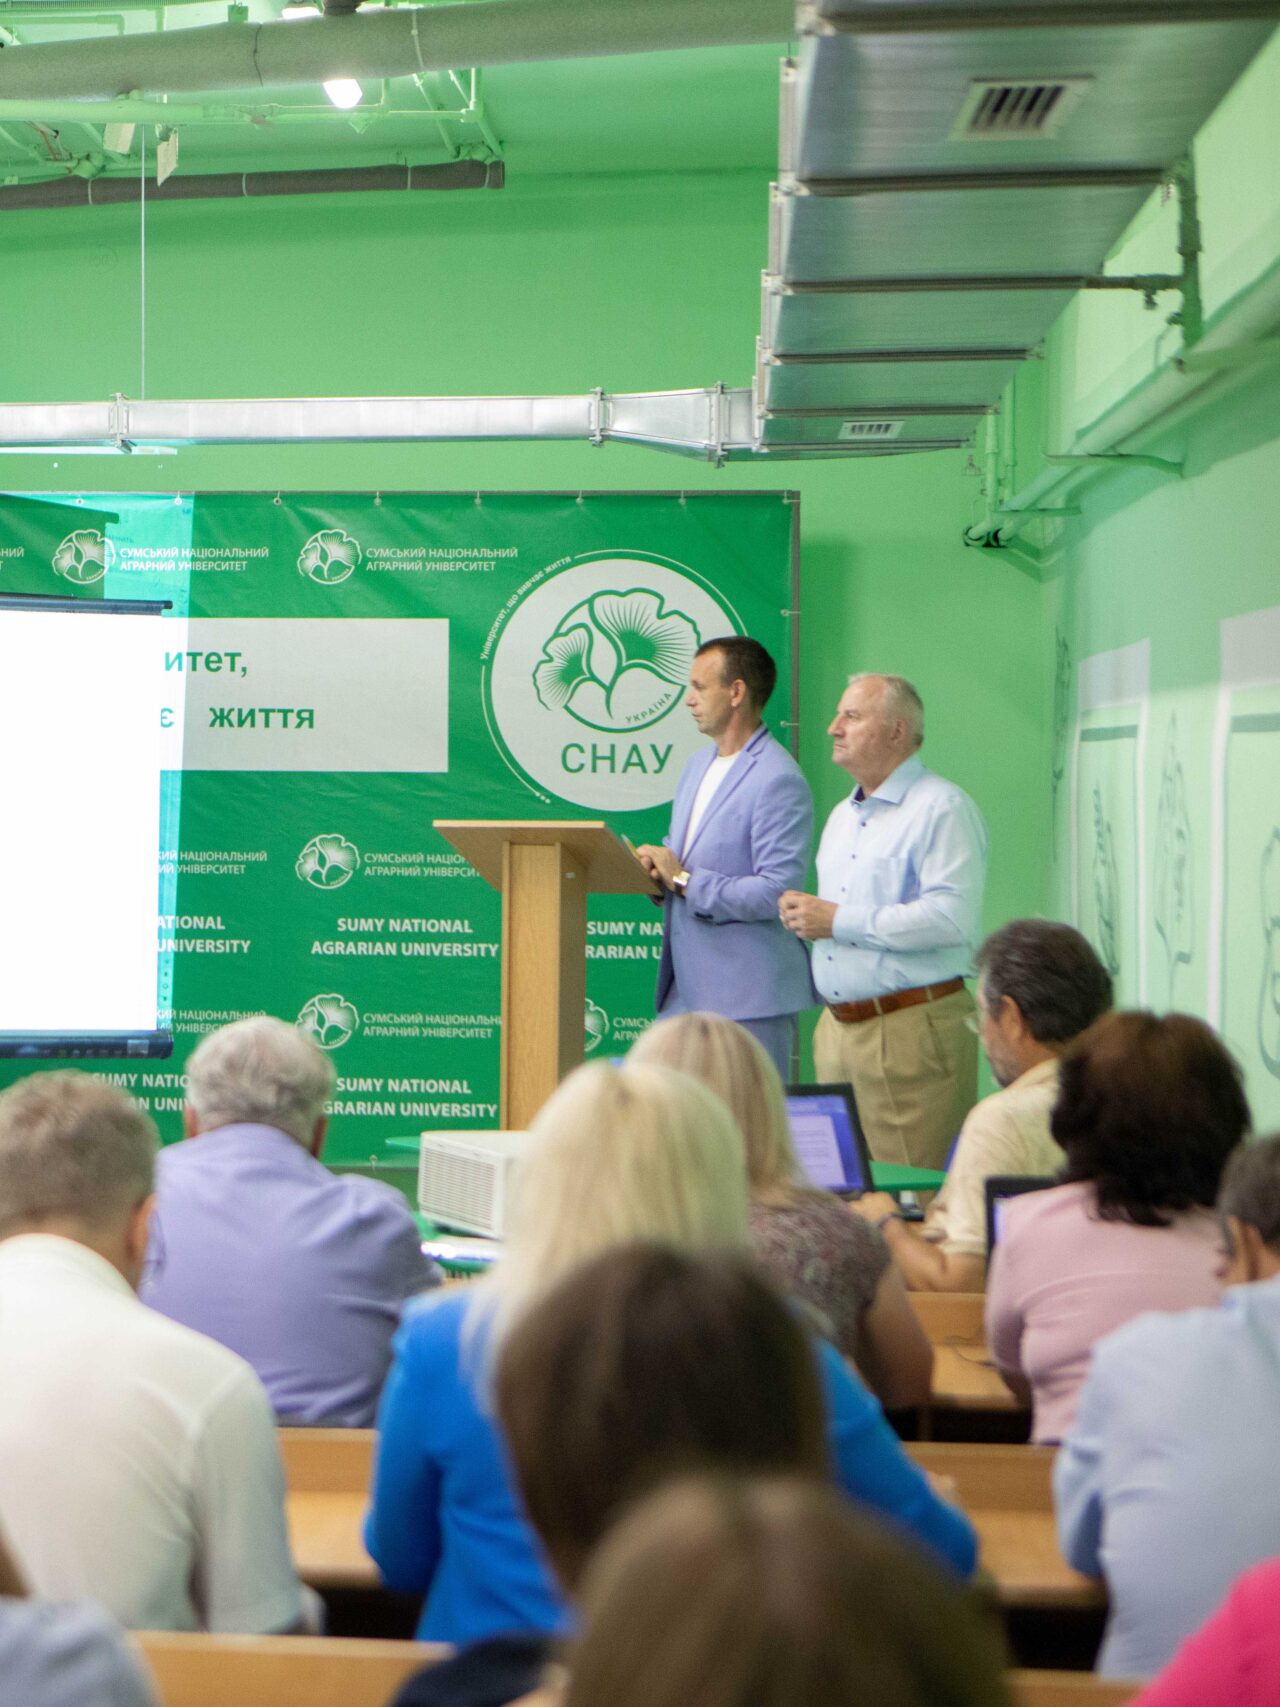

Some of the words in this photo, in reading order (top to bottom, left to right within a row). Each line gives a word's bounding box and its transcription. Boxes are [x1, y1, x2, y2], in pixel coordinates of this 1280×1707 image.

[120, 546, 178, 558] СУМСЬКИЙ
[182, 547, 269, 559] НАЦІОНАЛЬНИЙ
[366, 547, 426, 558] СУМСЬКИЙ
[429, 547, 518, 559] НАЦІОНАЛЬНИЙ
[120, 560, 175, 571] АГРАРНИЙ
[178, 561, 248, 571] УНІВЕРСИТЕТ
[366, 560, 422, 571] АГРАРНИЙ
[425, 561, 496, 571] УНІВЕРСИТЕТ
[209, 707, 314, 729] життя
[561, 742, 673, 774] СНАУ
[180, 850, 267, 862] НАЦІОНАЛЬНИЙ
[364, 852, 424, 864] СУМСЬКИЙ
[178, 864, 246, 874] УНІВЕРСИТЕТ
[364, 866, 420, 876] АГРАРНИЙ
[337, 918, 384, 932] SUMY
[389, 918, 473, 933] NATIONAL
[586, 921, 635, 935] SUMY
[158, 939, 250, 953] UNIVERSITY
[311, 941, 397, 957] AGRARIAN
[401, 942, 499, 957] UNIVERSITY
[363, 1012, 422, 1024] СУМСЬКИЙ
[363, 1025, 419, 1036] АГРАРНИЙ
[422, 1027, 493, 1038] УНІВЕРСИТЕТ
[337, 1077, 383, 1092] SUMY
[388, 1079, 472, 1094] NATIONAL
[400, 1102, 497, 1117] UNIVERSITY
